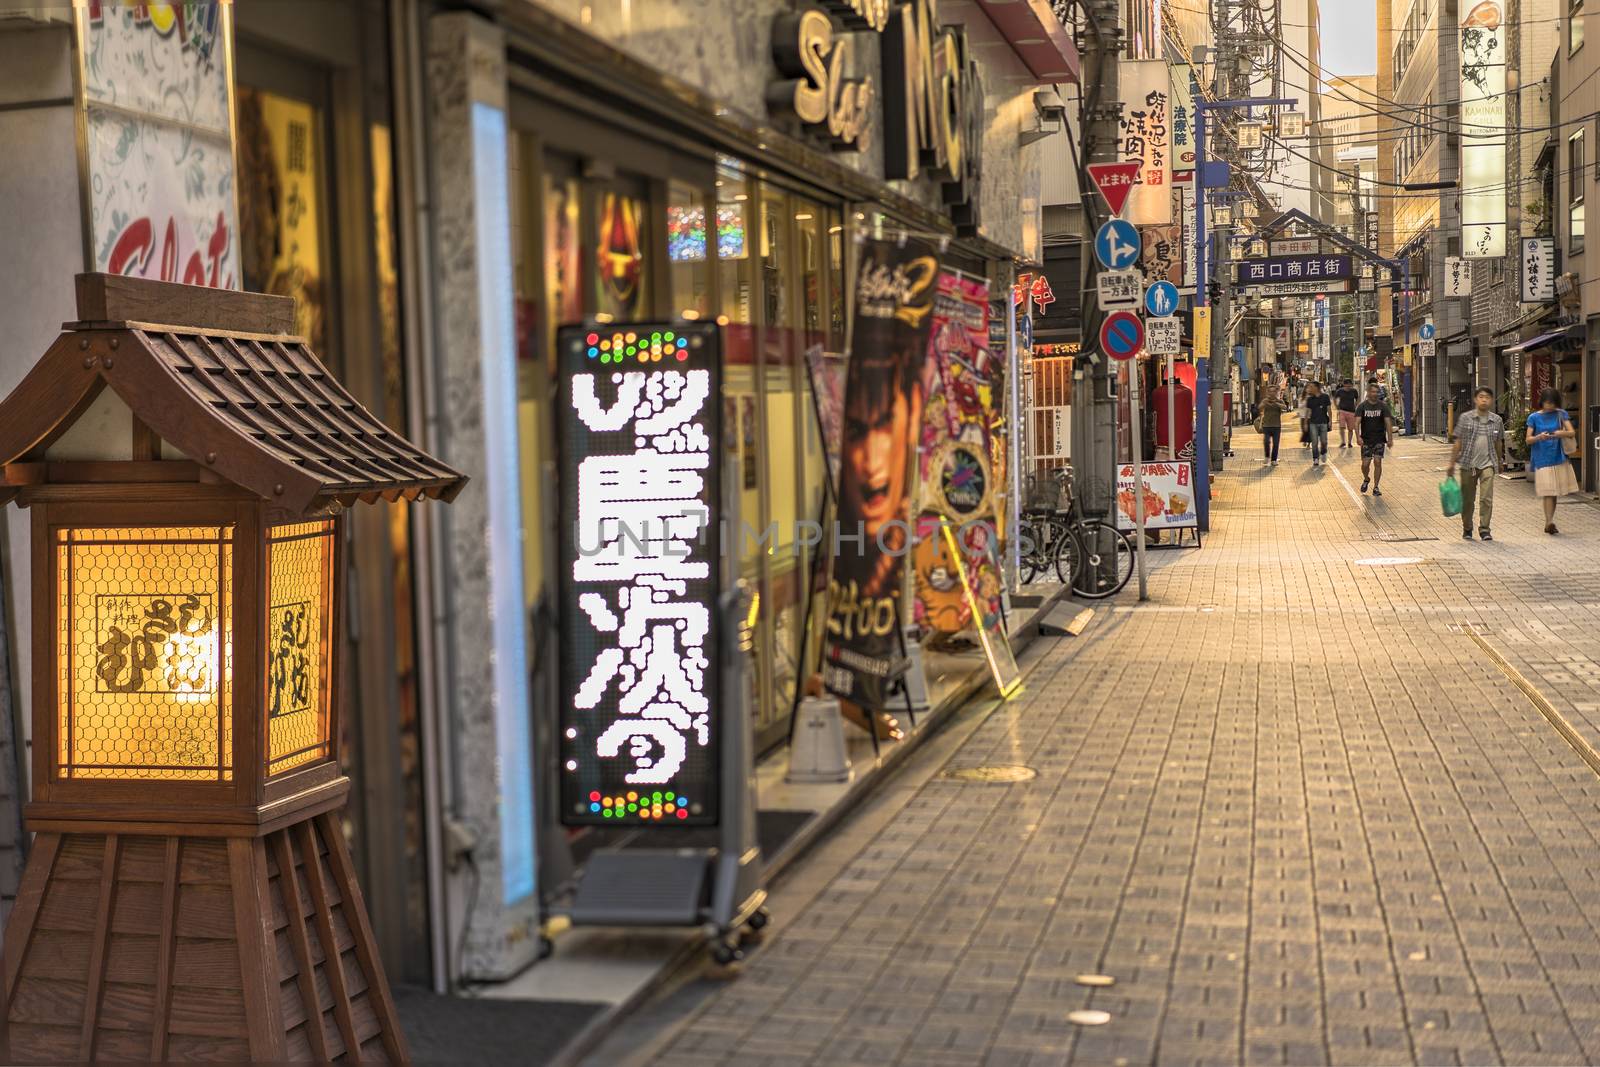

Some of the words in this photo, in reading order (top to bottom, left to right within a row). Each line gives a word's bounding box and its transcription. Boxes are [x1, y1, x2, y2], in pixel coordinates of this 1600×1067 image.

[1146, 90, 1167, 167] 時代遅れの
[1174, 106, 1187, 146] 治療院
[1100, 173, 1131, 187] 止まれ
[1278, 241, 1312, 252] 神田駅
[1477, 226, 1491, 255] このはな
[1250, 259, 1340, 279] 西口商店街
[1101, 274, 1139, 288] 自転車を除く
[1101, 286, 1139, 297] 一方通行
[1273, 282, 1328, 294] 神田外語学院
[1148, 321, 1177, 330] 自転車を除く
[1364, 409, 1381, 417] YOUTH
[113, 613, 139, 626] 料理
